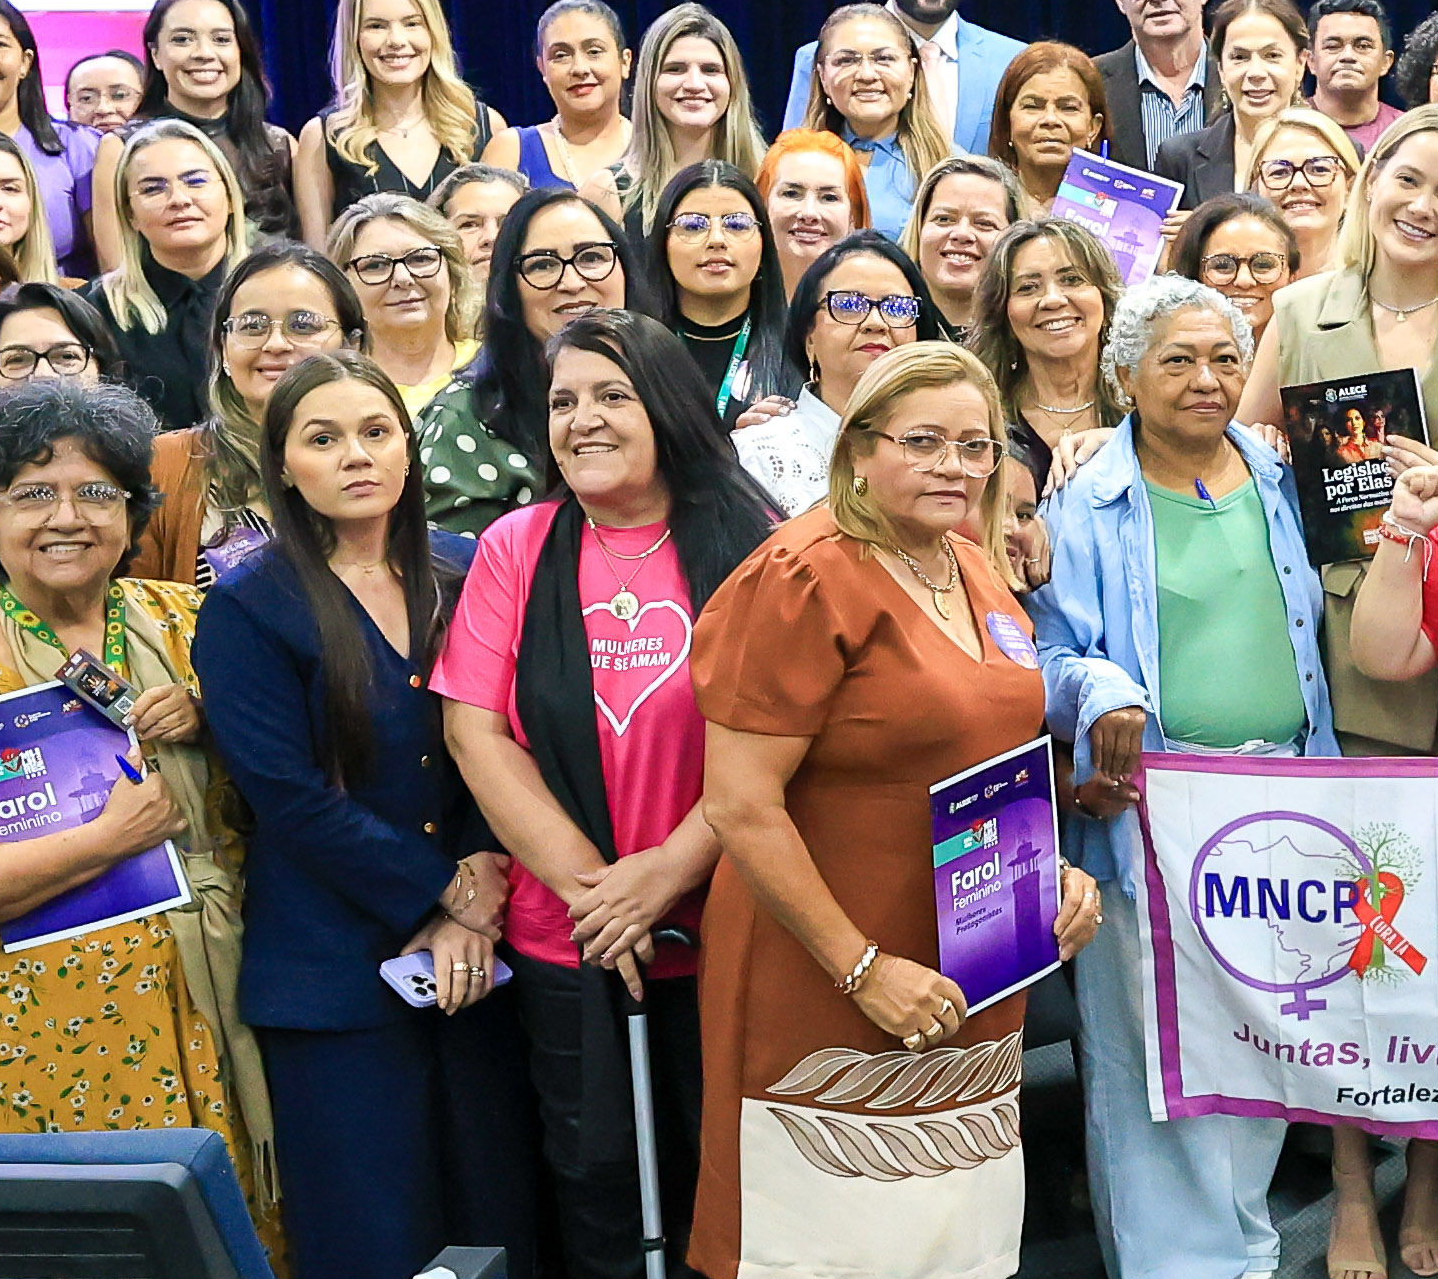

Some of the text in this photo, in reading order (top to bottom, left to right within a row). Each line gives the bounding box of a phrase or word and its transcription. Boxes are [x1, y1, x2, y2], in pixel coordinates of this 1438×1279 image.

[1338, 384, 1368, 397] ALECE
[1322, 460, 1390, 483] Legislaç
[1325, 475, 1393, 501] por Elas
[591, 637, 664, 656] MULHERES
[590, 652, 672, 672] UE SE AMAM
[950, 852, 1001, 897] Farol
[952, 880, 1002, 912] Feminino
[1204, 872, 1361, 924] MNCP
[1369, 914, 1398, 946] CURA
[1233, 1022, 1371, 1070] Juntas,
